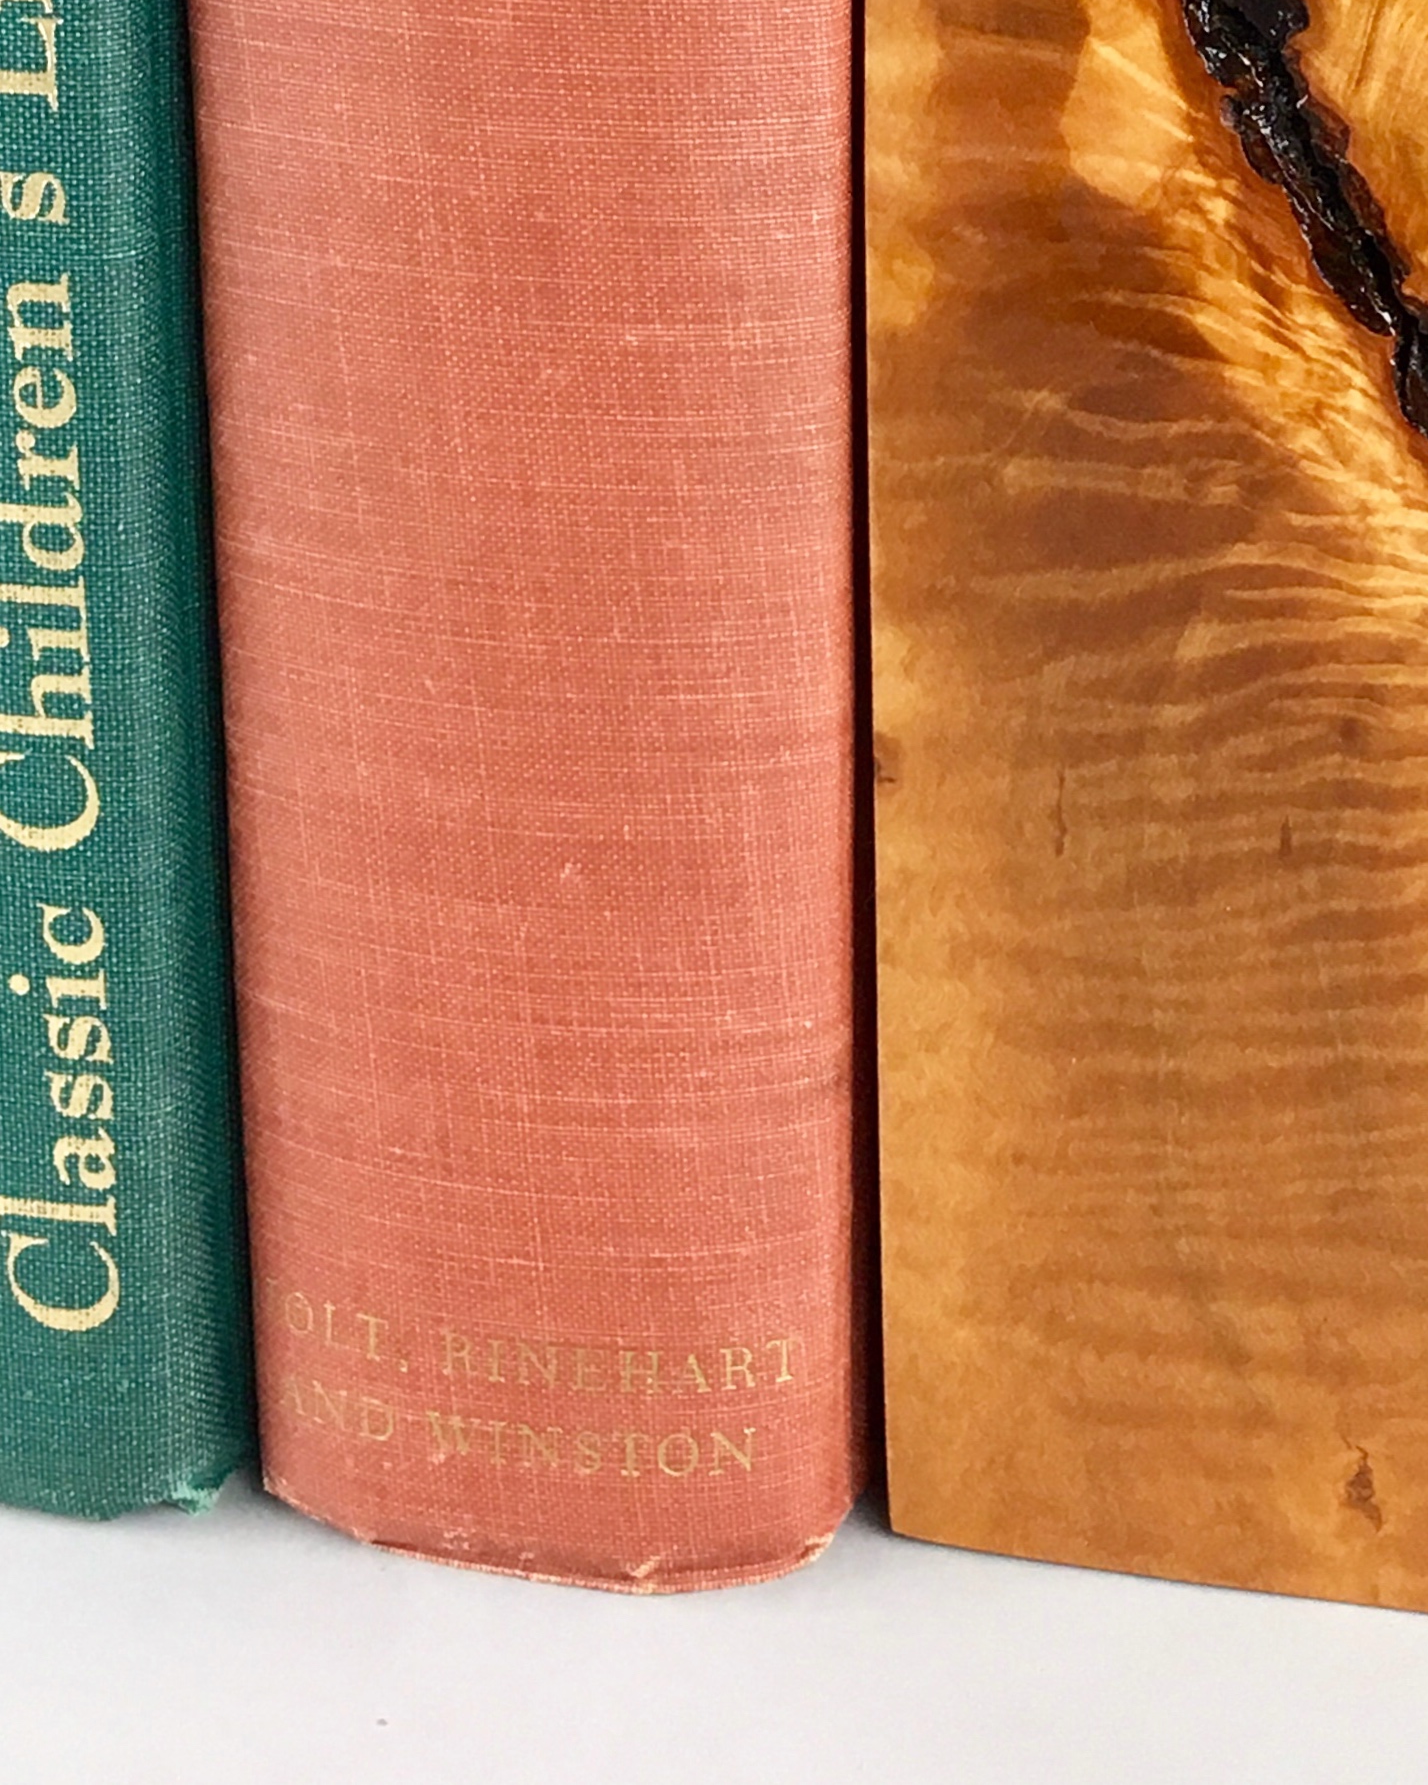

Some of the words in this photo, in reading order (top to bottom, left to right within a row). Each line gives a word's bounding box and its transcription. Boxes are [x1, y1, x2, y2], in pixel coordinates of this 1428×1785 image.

[0, 901, 120, 1332] Classic
[440, 1327, 804, 1396] RINEHART
[425, 1410, 758, 1479] WINSTON
